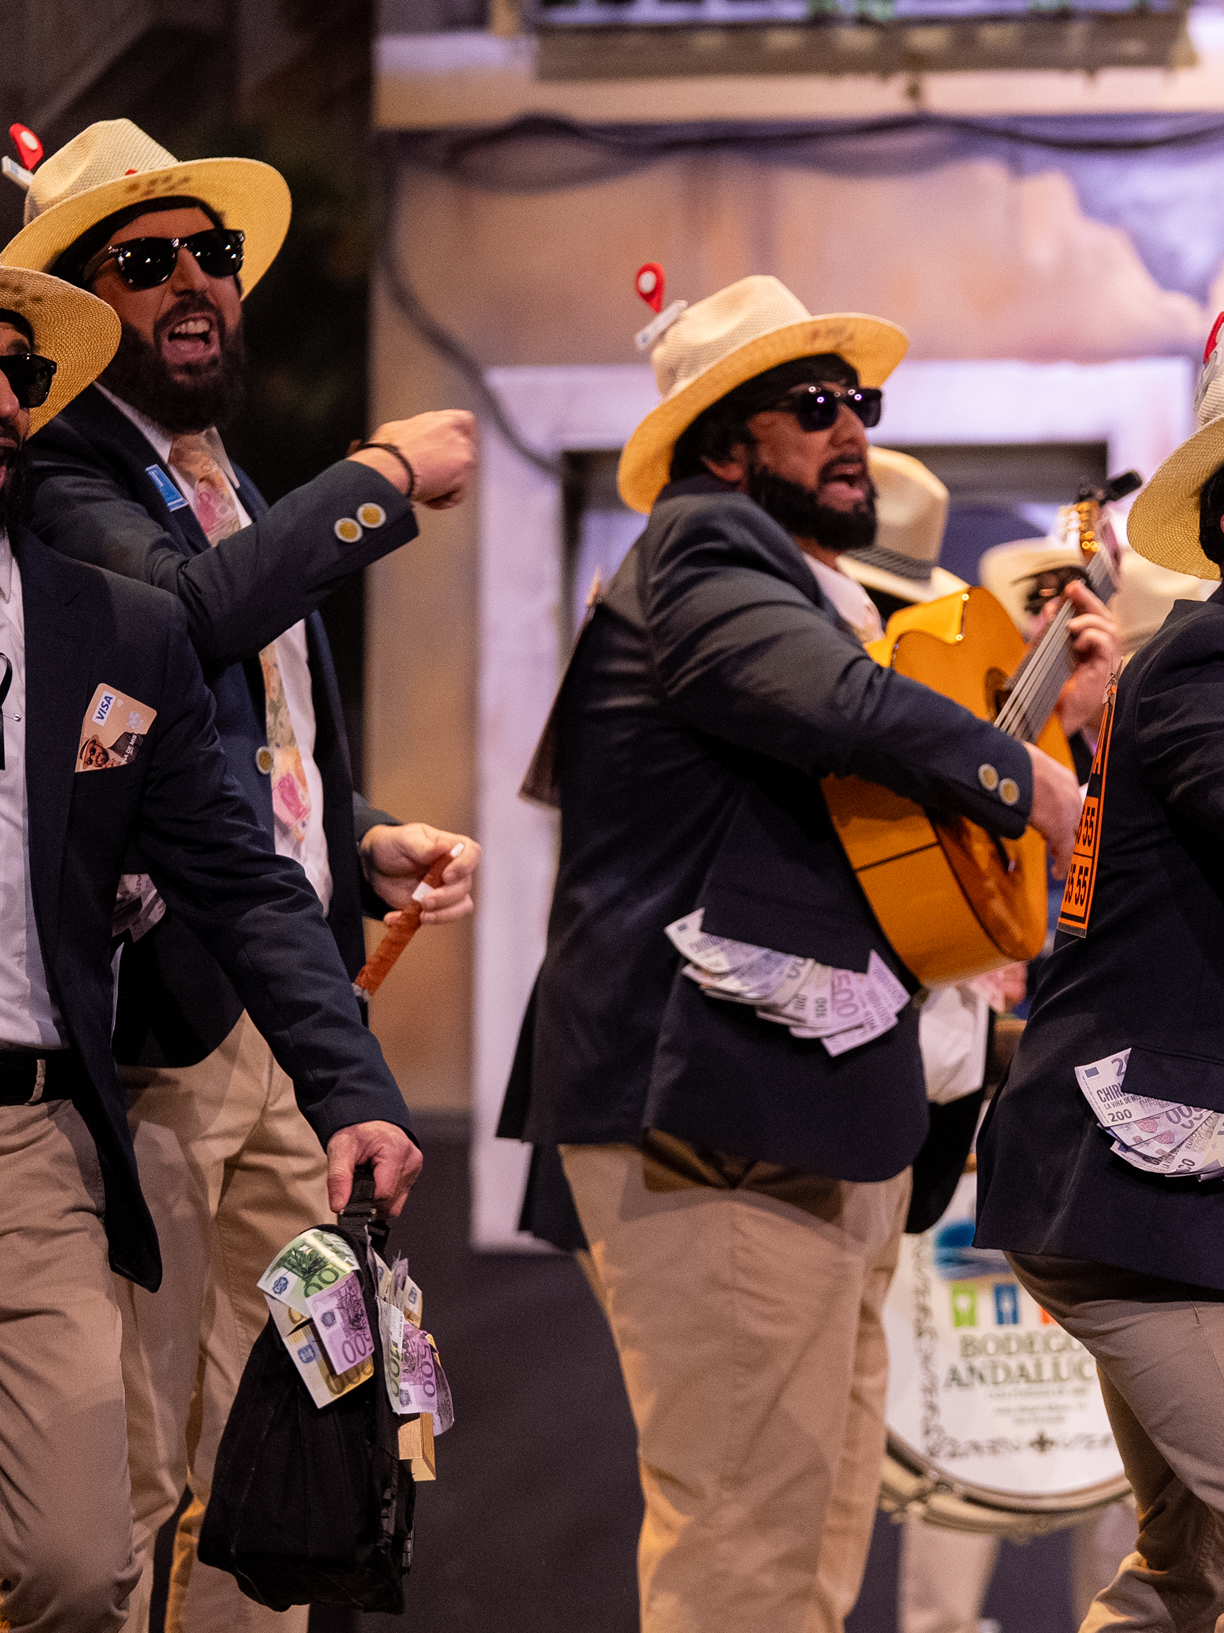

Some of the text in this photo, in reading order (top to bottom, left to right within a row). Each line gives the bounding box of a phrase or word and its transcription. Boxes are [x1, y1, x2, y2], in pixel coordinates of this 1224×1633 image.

[95, 695, 113, 720] VISA
[1108, 1109, 1132, 1122] 200
[420, 1344, 436, 1398] 500
